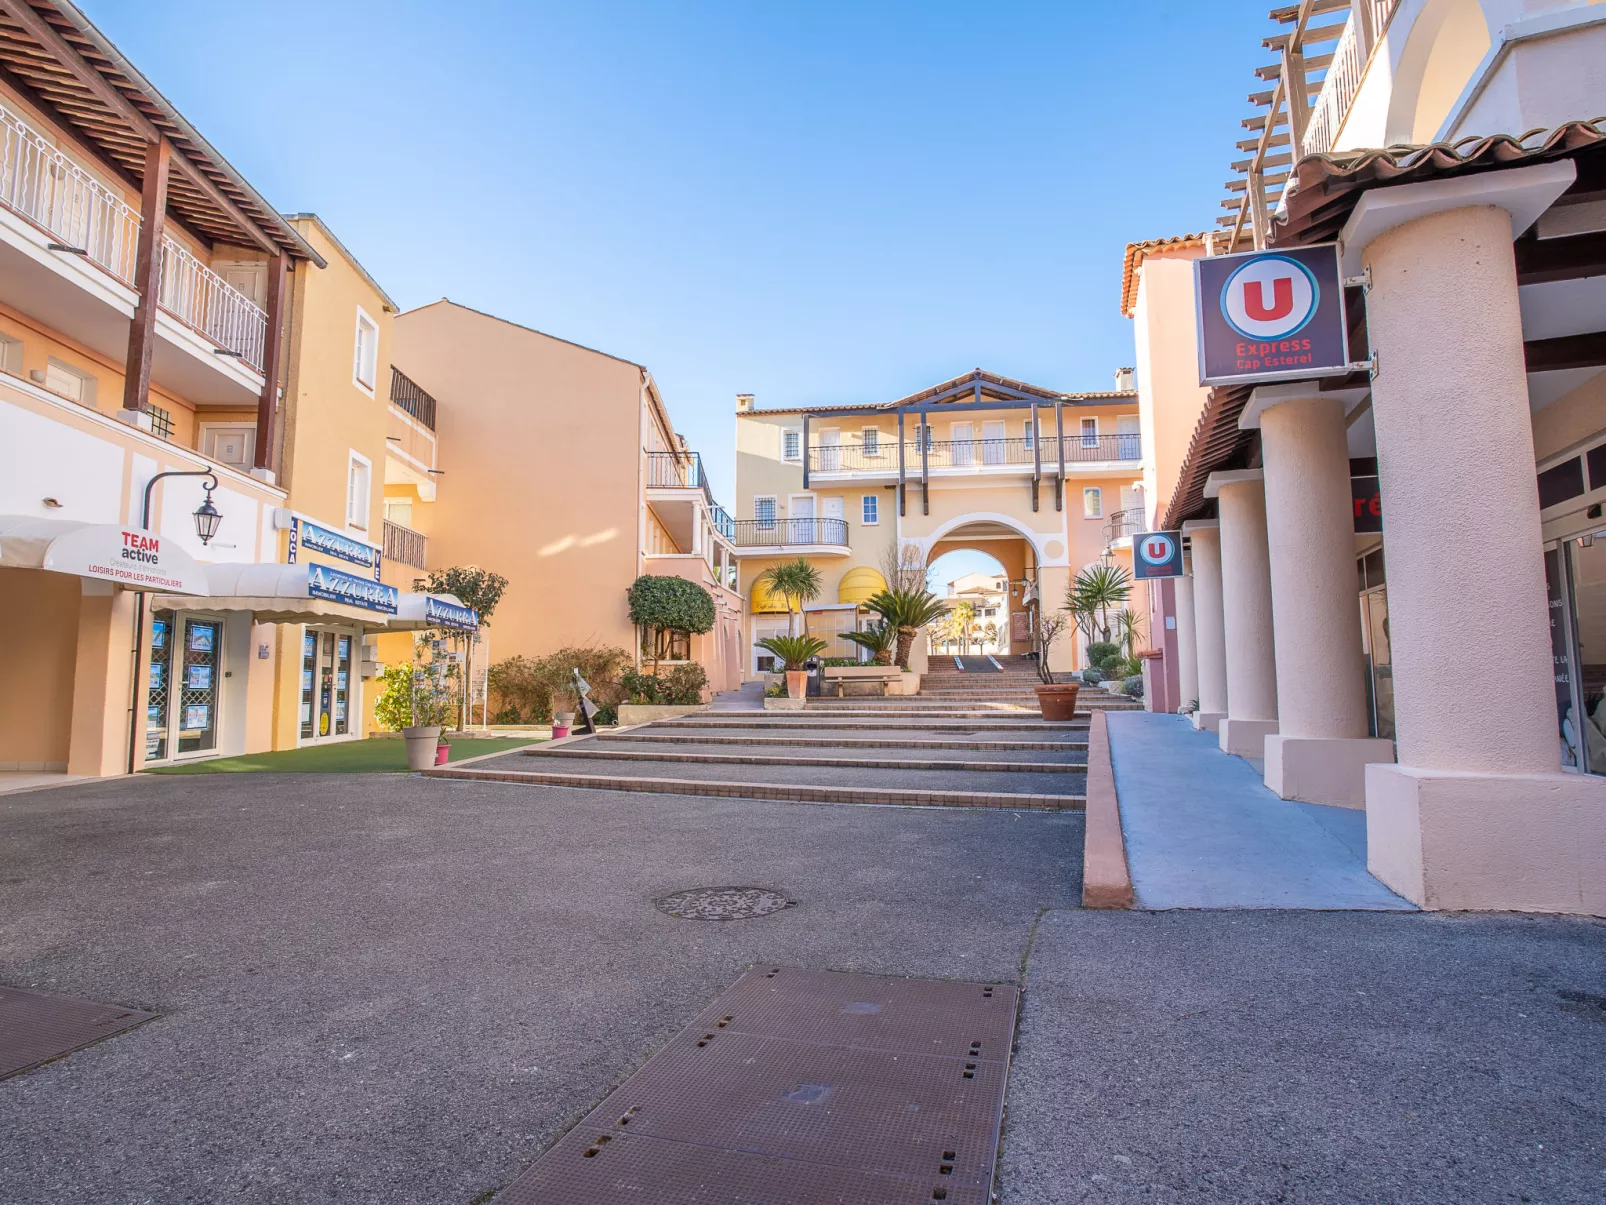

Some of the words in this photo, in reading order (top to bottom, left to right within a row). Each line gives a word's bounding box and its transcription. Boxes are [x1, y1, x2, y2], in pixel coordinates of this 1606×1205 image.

[1243, 277, 1294, 322] U
[1236, 338, 1312, 357] Express
[1237, 358, 1261, 370] Cap
[1265, 353, 1313, 368] Esterel
[121, 531, 159, 553] TEAM
[1148, 542, 1166, 559] U
[121, 547, 159, 565] active
[88, 564, 114, 576] LOISIRS
[115, 569, 133, 579] POUR
[133, 573, 145, 582] LES
[145, 576, 183, 589] PARTICULIERS
[308, 567, 398, 608] AZZURRA
[426, 598, 478, 626] AZZURRA
